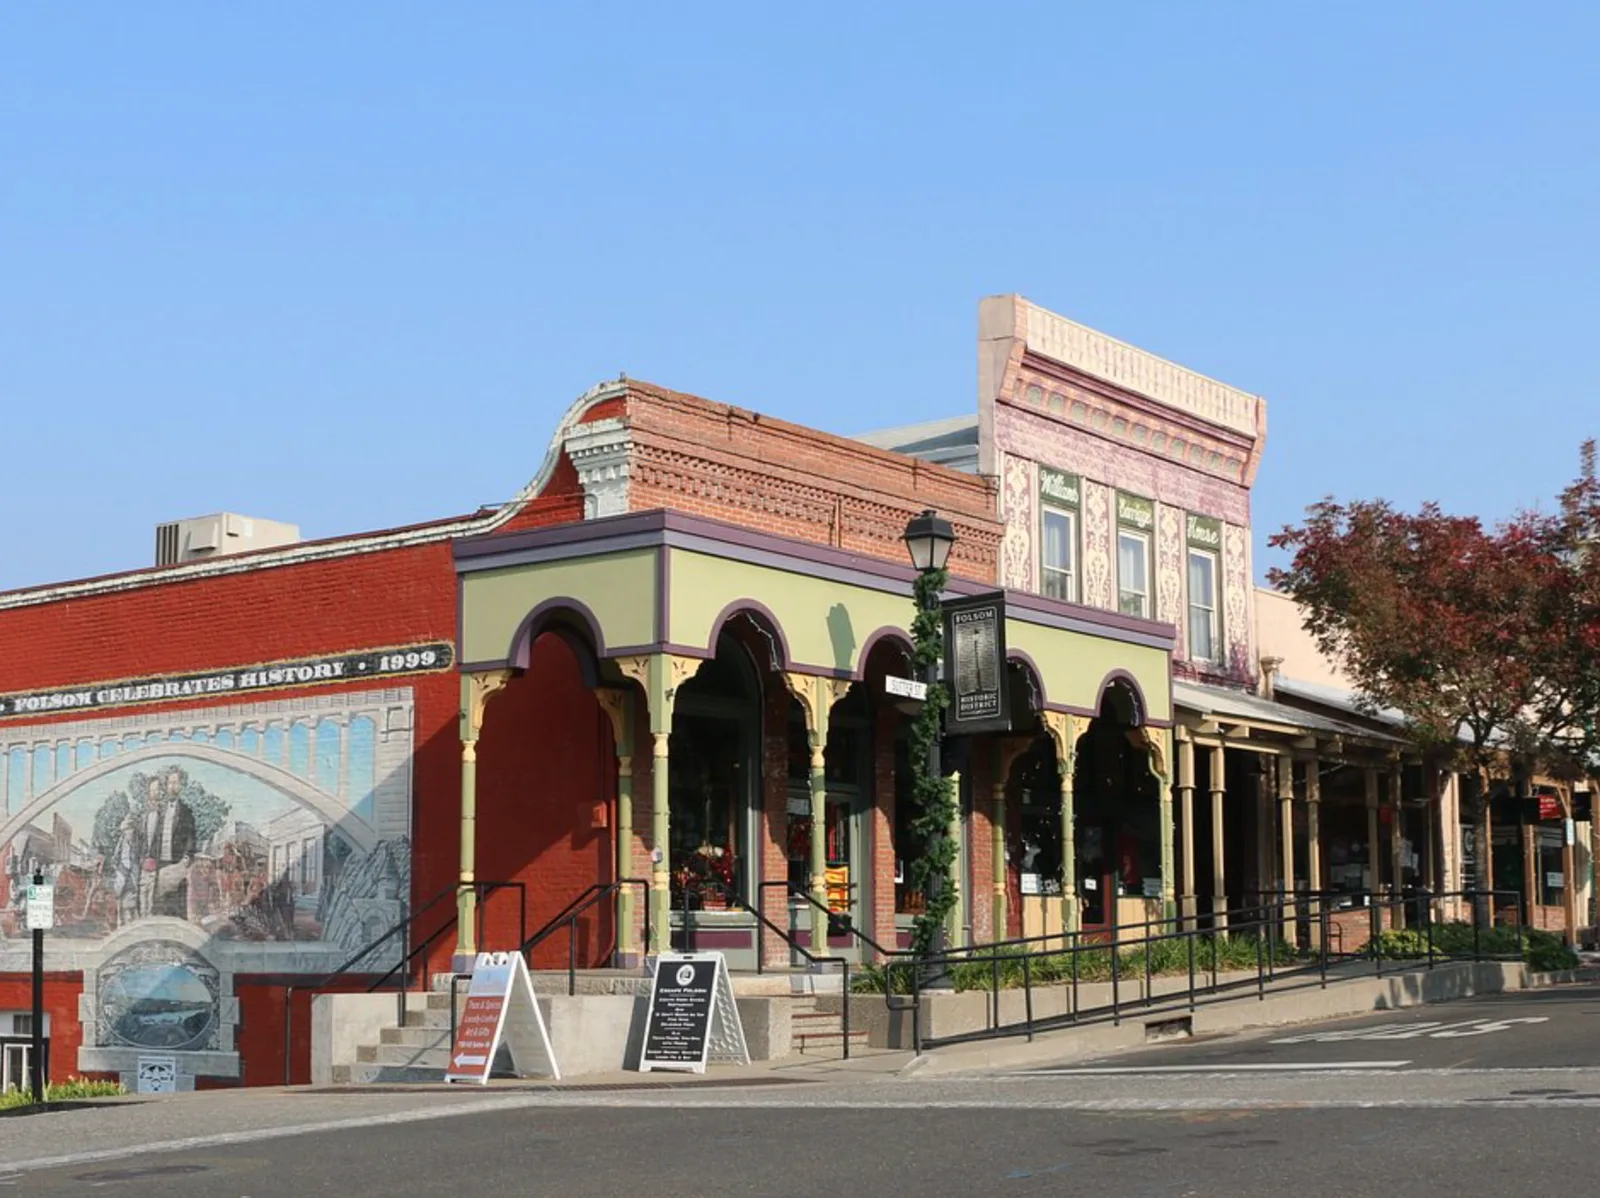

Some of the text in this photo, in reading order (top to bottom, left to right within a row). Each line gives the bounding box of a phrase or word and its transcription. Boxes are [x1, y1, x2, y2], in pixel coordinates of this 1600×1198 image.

[1188, 516, 1219, 544] House
[956, 610, 993, 623] FOLSOM
[14, 650, 436, 712] FOLSOM CELEBRATES HISTORY 1999
[961, 693, 997, 703] HISTORIC
[961, 700, 997, 711] DISTRICT
